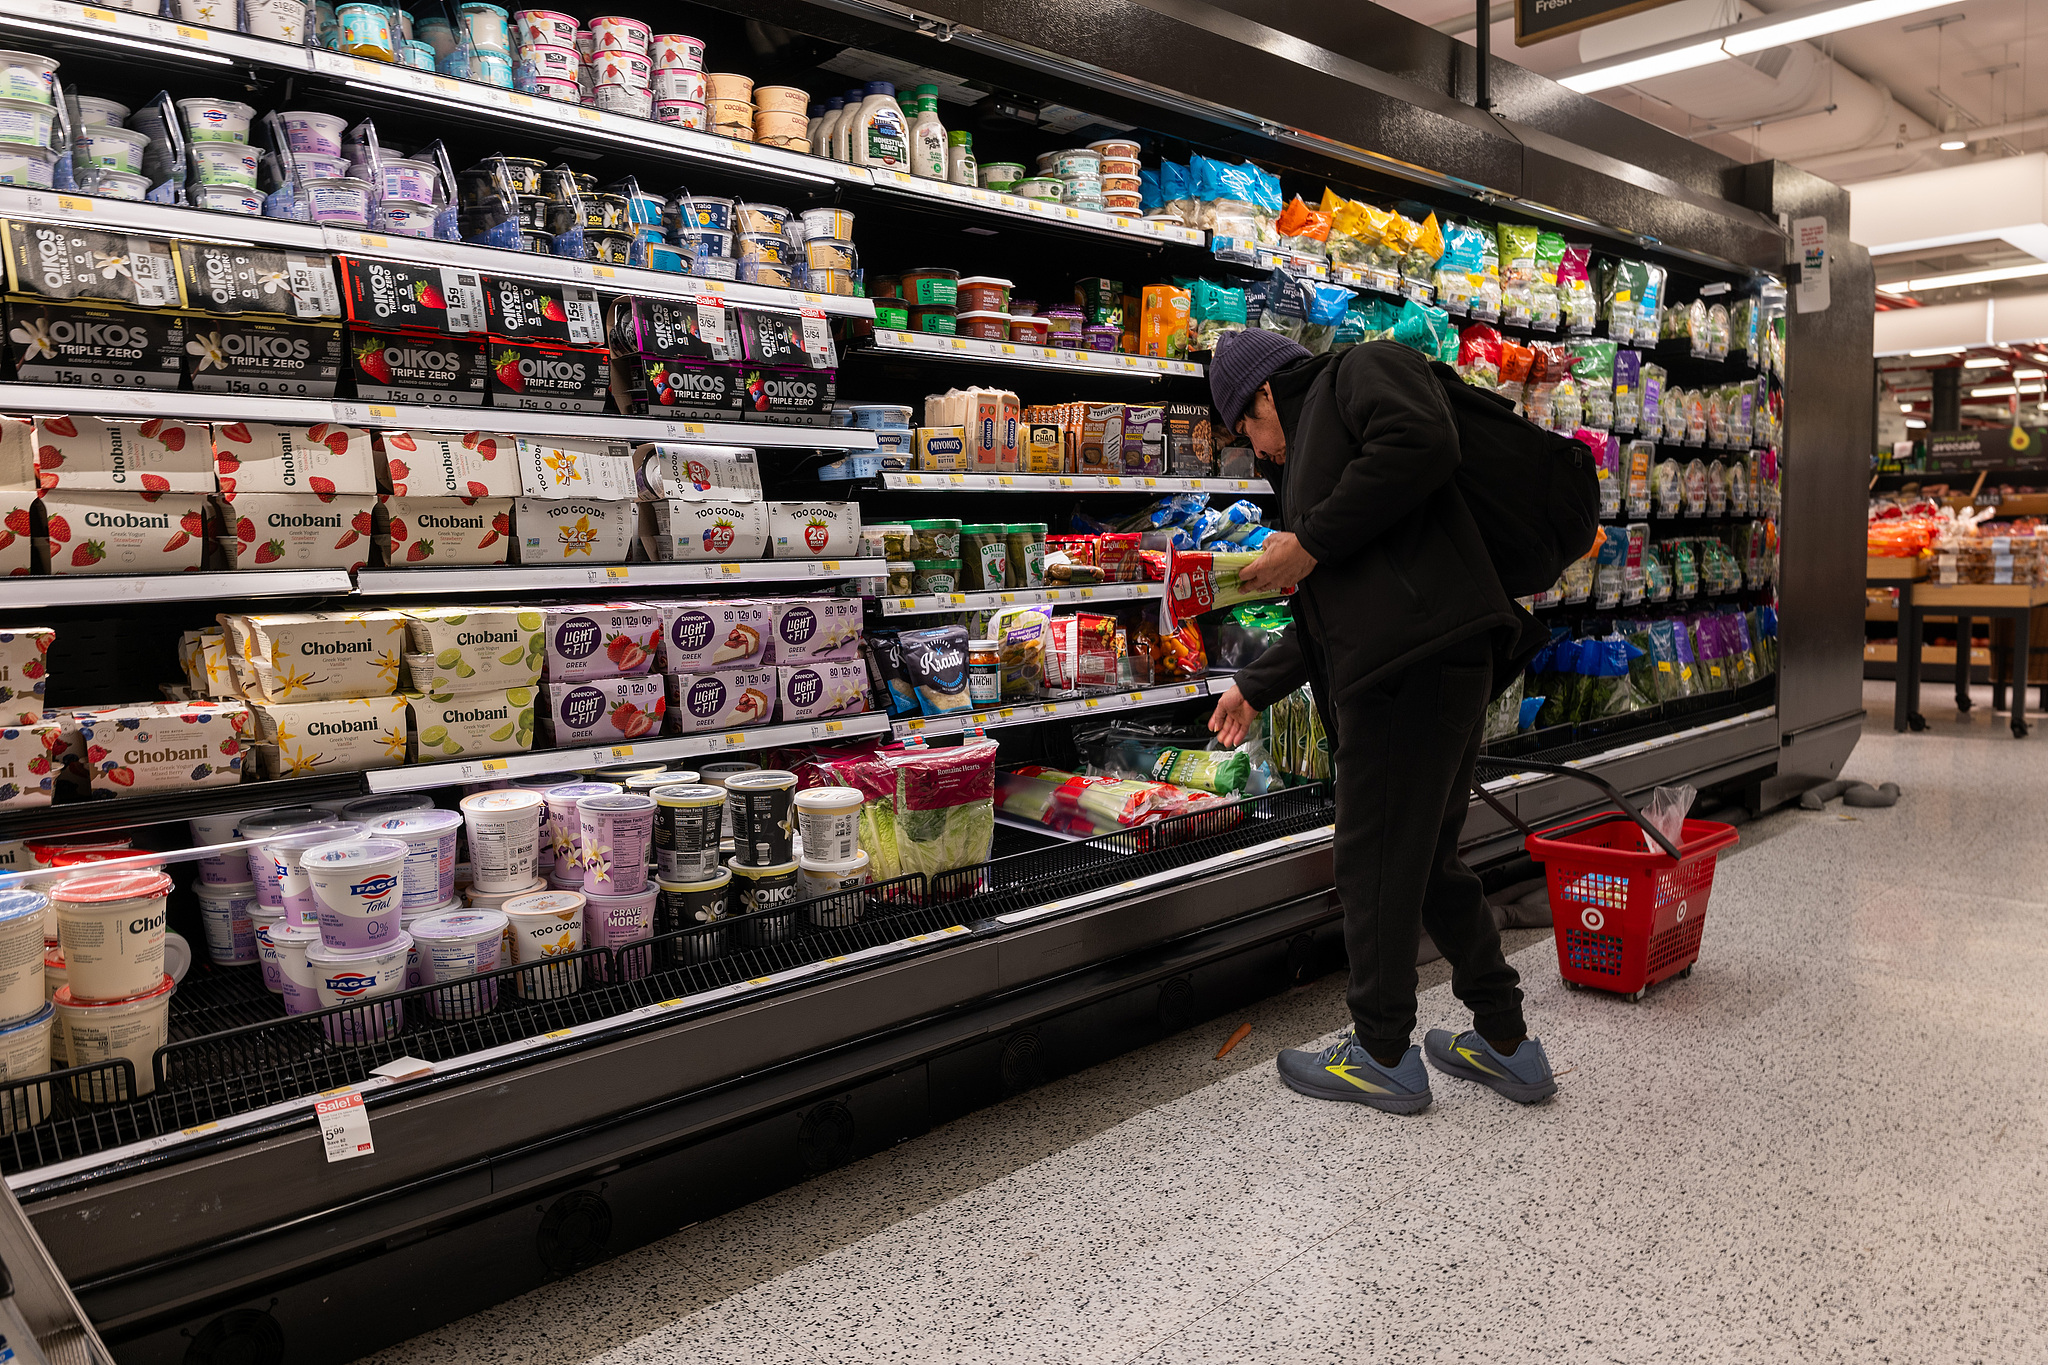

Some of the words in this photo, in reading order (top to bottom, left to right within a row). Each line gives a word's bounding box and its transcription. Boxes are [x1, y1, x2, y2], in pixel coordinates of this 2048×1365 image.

[584, 207, 605, 215] PRO
[611, 244, 627, 253] PRO
[613, 252, 625, 260] 20g
[36, 229, 63, 289] OIKOS
[136, 256, 152, 288] 15g
[204, 248, 229, 304] OIKOS
[383, 269, 391, 289] ZERO
[295, 269, 309, 293] 15g
[368, 264, 390, 318] OIKOS
[446, 287, 460, 309] 15g
[384, 290, 397, 314] TRIPLE
[499, 280, 518, 331] OIKOS
[696, 296, 717, 307] Sale!
[568, 303, 581, 322] 15g
[801, 308, 820, 318] Sale!
[50, 321, 149, 349] OIKOS
[652, 304, 669, 350] OIKOS
[758, 316, 773, 359] OIKOS
[59, 344, 103, 357] TRIPLE
[106, 348, 143, 359] ZERO
[221, 334, 311, 360] OIKOS
[229, 356, 271, 368] TRIPLE
[272, 359, 305, 370] ZERO
[383, 347, 461, 373] OIKOS
[54, 370, 82, 386] 15g
[391, 367, 426, 379] TRIPLE
[428, 370, 456, 381] ZERO
[518, 358, 587, 382] OIKOS
[225, 380, 250, 393] 15g
[524, 377, 554, 388] TRIPLE
[557, 380, 583, 390] ZERO
[668, 373, 726, 393] OIKOS
[764, 381, 818, 399] OIKOS
[387, 390, 410, 402] 15g
[674, 390, 700, 400] TRIPLE
[702, 392, 722, 400] ZERO
[768, 397, 790, 406] TRIPLE
[794, 399, 814, 407] ZERO
[519, 398, 539, 410] 15g
[1092, 406, 1121, 418] TOFURKY
[1133, 408, 1158, 420] TOFURKY
[930, 440, 960, 451] MIYOKO'S
[107, 427, 126, 483] Chobani
[278, 432, 296, 486] Chobani
[438, 440, 457, 491] Chobani
[547, 506, 569, 519] TOO
[570, 505, 600, 518] GOOD
[695, 507, 714, 519] TOO
[715, 507, 740, 519] GOOD
[791, 508, 809, 520] TOO
[810, 508, 834, 519] GOOD
[84, 512, 170, 529] Chobani
[267, 513, 341, 529] Chobani
[418, 514, 484, 529] Chobani
[567, 526, 587, 543] 2G
[713, 527, 730, 541] 2G
[808, 527, 824, 541] 2G
[566, 621, 590, 629] DANNON
[611, 616, 621, 626] 80
[625, 616, 638, 626] 12g
[642, 615, 652, 625] 0g
[786, 616, 812, 633] LIGHT
[564, 628, 596, 646] LIGHT
[679, 621, 709, 638] LIGHT
[793, 628, 809, 641] FIT
[457, 629, 518, 647] Chobani
[688, 634, 706, 648] FIT
[301, 638, 372, 656] Chobani
[572, 642, 592, 656] FIT
[566, 661, 588, 669] GREEK
[920, 649, 963, 675] Kraut
[793, 678, 819, 696] LIGHT
[693, 686, 720, 705] LIGHT
[443, 706, 508, 723] Chobani
[569, 696, 601, 717] LIGHT
[307, 716, 379, 736] Chobani
[577, 711, 596, 726] FIT
[571, 730, 593, 738] GREEK
[124, 744, 208, 765] Chobani
[937, 767, 962, 776] Romaine
[963, 763, 980, 773] Hearts
[1160, 752, 1178, 782] RGANIC
[362, 896, 392, 914] Total
[612, 906, 642, 917] CRAVE
[367, 920, 389, 935] 0%
[607, 915, 640, 927] MORE
[530, 926, 553, 938] TOO
[317, 1099, 351, 1114] Sale!
